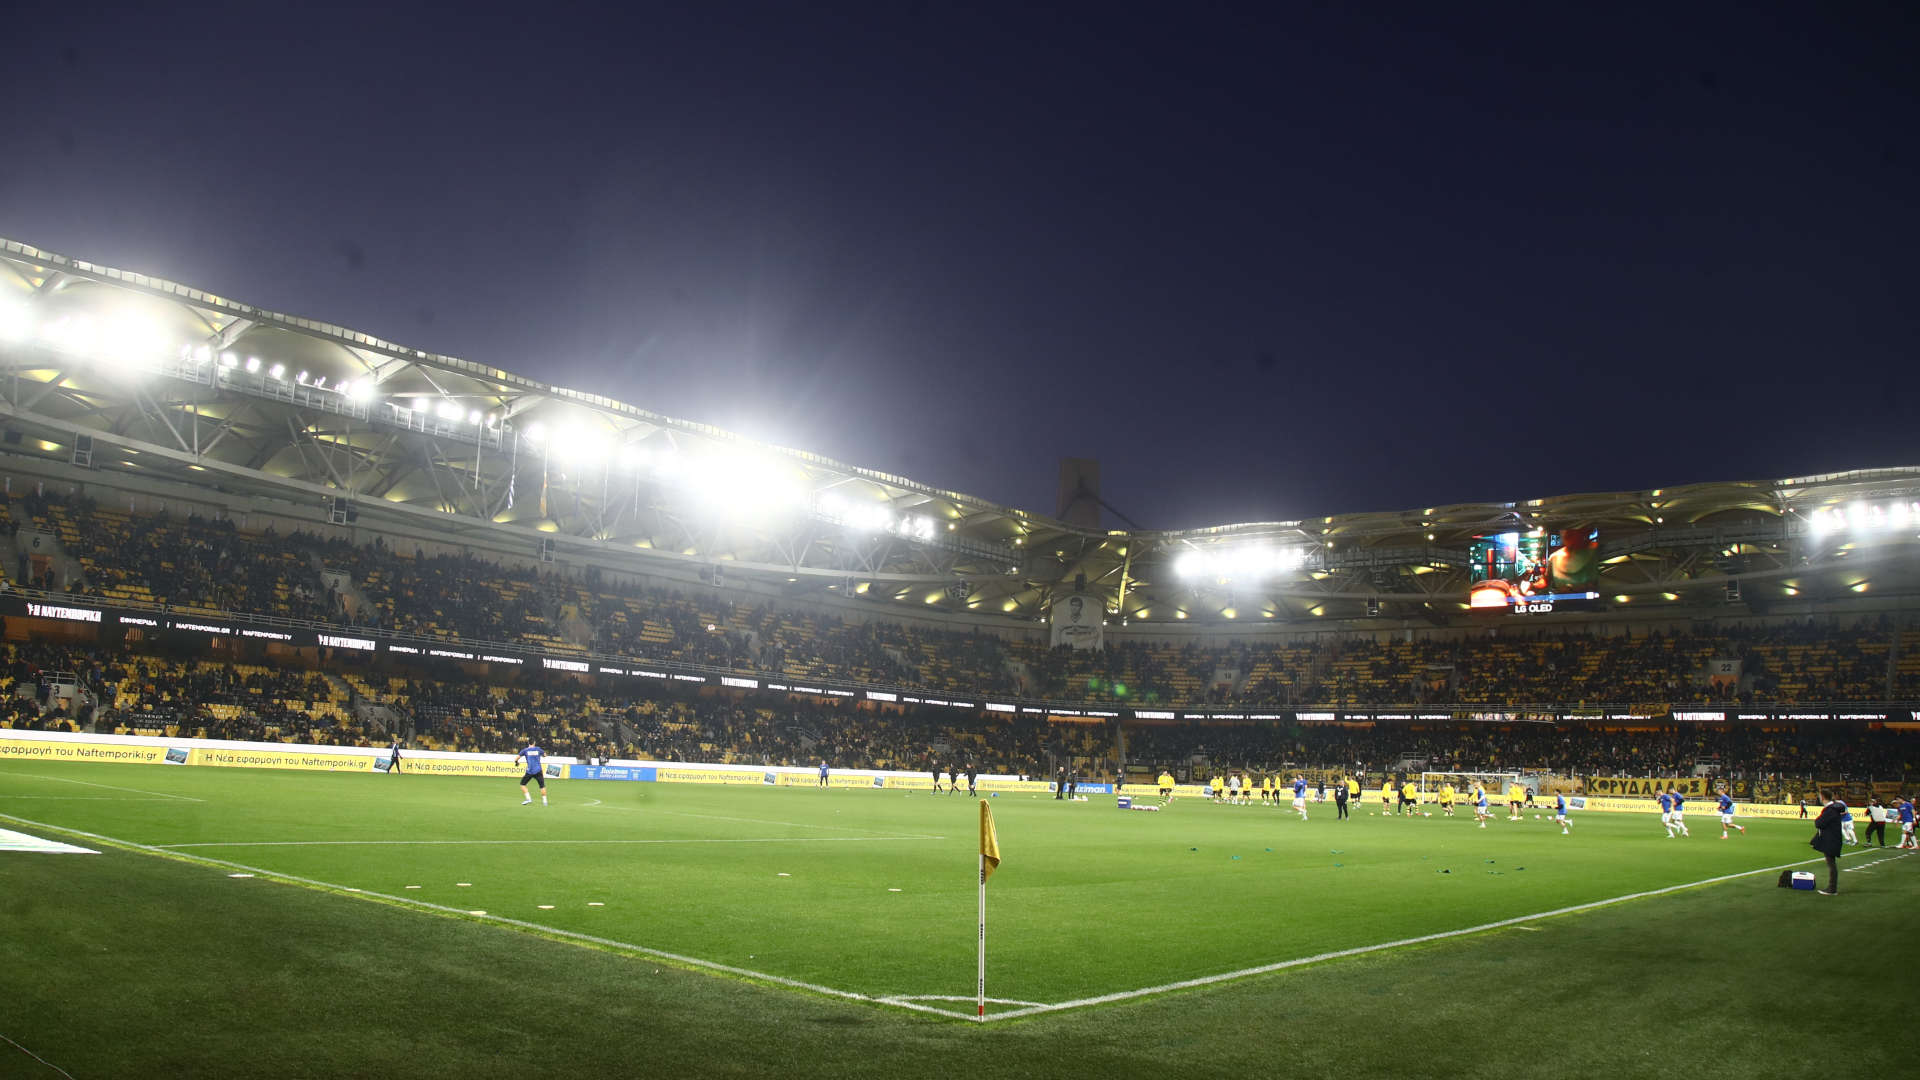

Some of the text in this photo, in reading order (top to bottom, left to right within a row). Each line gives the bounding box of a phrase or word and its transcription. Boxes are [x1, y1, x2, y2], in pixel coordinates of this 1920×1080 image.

[1515, 604, 1552, 613] LG OLED
[176, 623, 230, 634] NAFTEMPORIKI.GR
[1720, 664, 1731, 672] 22
[56, 748, 73, 756] του
[76, 748, 158, 761] Naftemporiki.gr
[215, 754, 234, 763] Νέα
[285, 758, 299, 766] του
[302, 757, 368, 769] Naftemporiki.gr
[415, 762, 430, 770] Νέα
[472, 765, 484, 773] του
[485, 765, 526, 774] Naftempori
[1766, 808, 1801, 817] εφαρμογ
